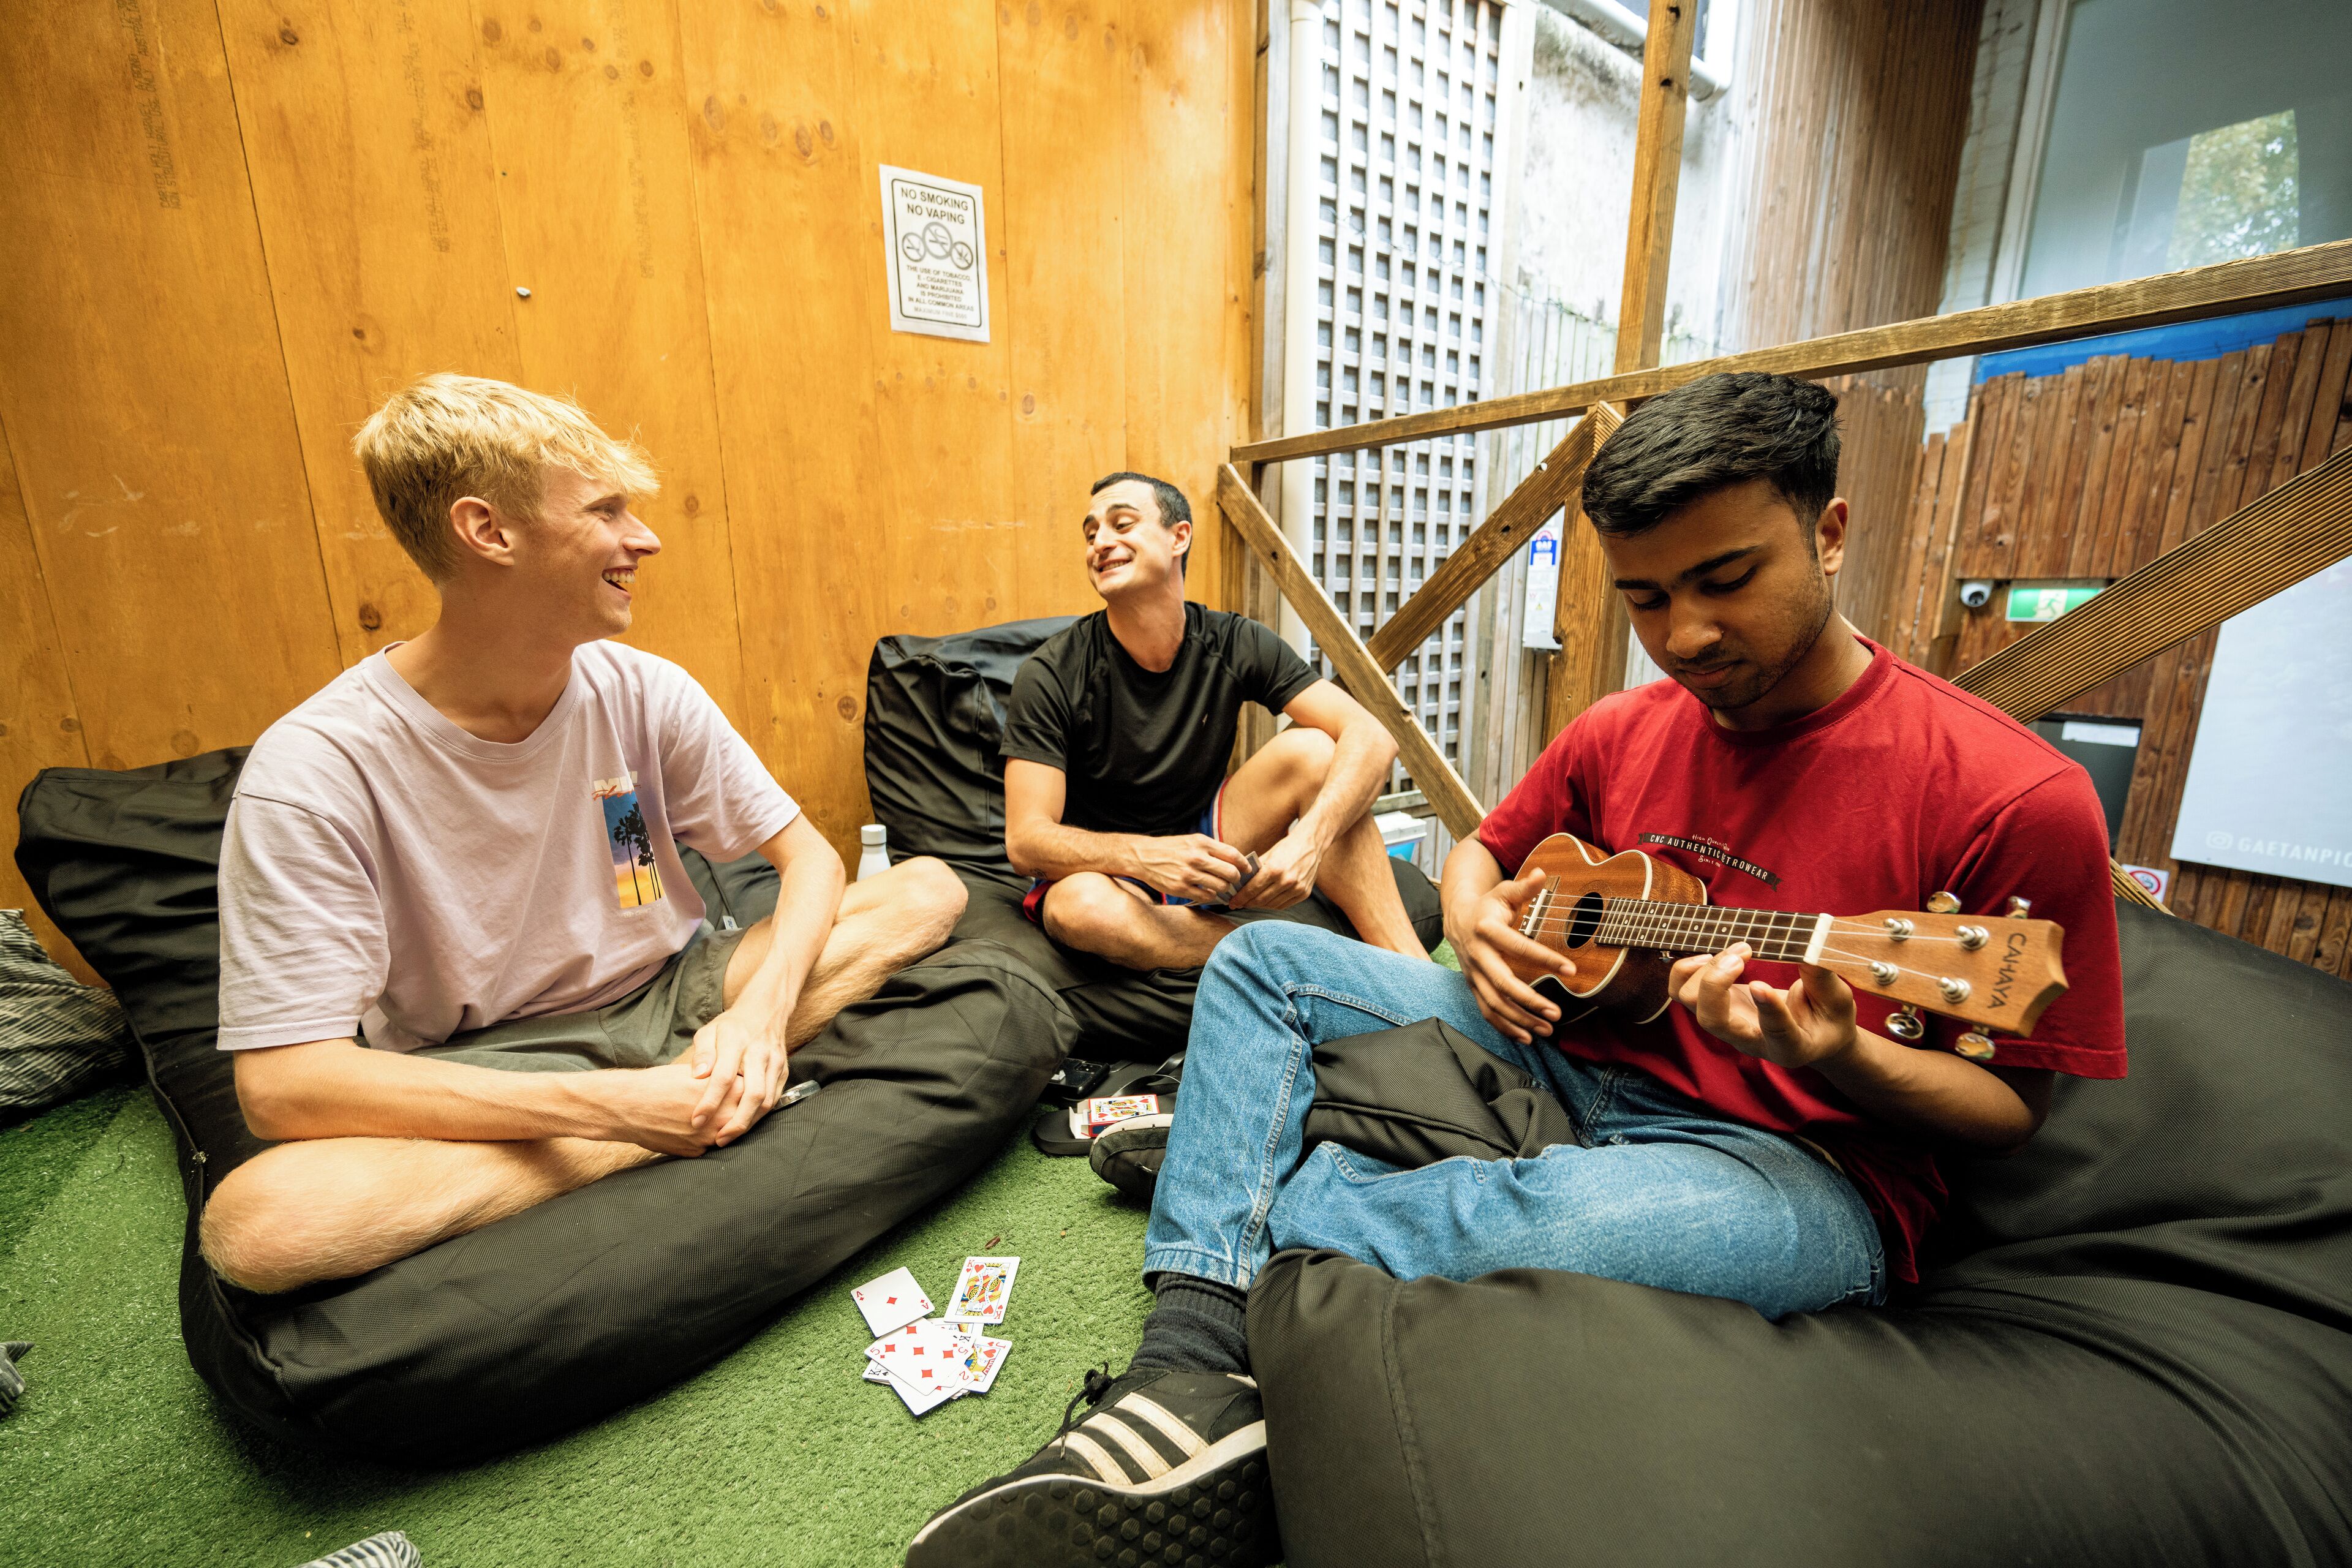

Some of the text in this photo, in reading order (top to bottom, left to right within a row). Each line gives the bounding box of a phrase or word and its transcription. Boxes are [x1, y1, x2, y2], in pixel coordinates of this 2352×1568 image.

[901, 187, 968, 211] NO SMOKING
[907, 203, 965, 224] NO VAPING
[927, 276, 962, 287] CIGARETTES
[931, 285, 963, 295] MARIJUANA
[927, 292, 962, 302] PROHIBITED
[929, 300, 954, 308] COMMON
[1650, 834, 1664, 843] CNC
[1667, 838, 1721, 859] AUTHENTIC
[1988, 933, 2027, 1009] CAHAYA
[993, 1311, 1002, 1319] K
[870, 1347, 880, 1355] 5
[958, 1346, 968, 1355] 5
[959, 1371, 969, 1381] 2
